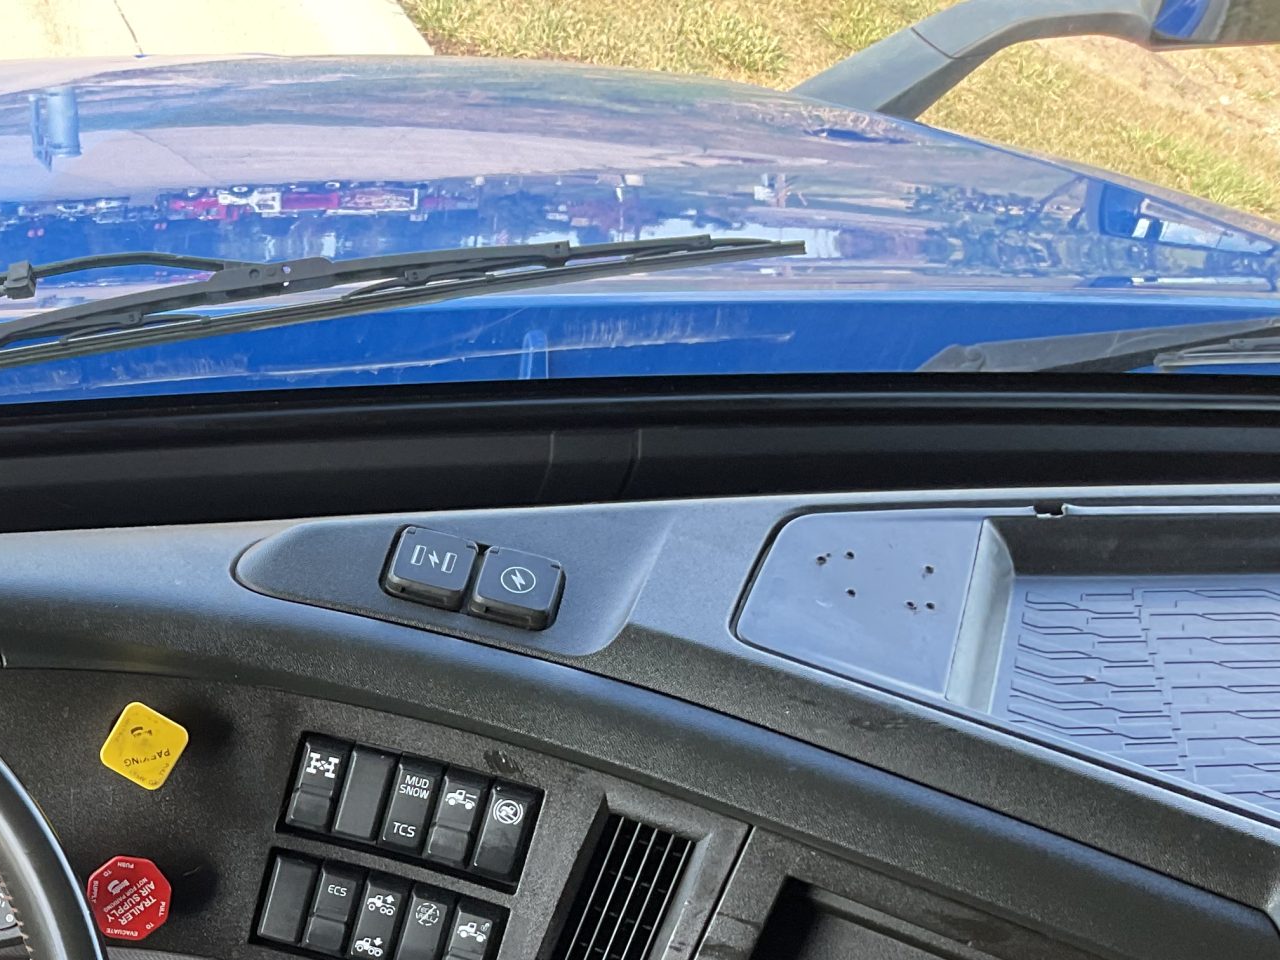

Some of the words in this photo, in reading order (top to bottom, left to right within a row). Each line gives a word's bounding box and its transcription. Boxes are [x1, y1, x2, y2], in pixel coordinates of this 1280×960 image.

[404, 774, 430, 789] MUD
[399, 784, 430, 800] SNOW
[392, 822, 417, 838] TCS
[117, 861, 135, 869] PUSH
[102, 869, 113, 877] TO
[134, 877, 149, 889] NOT
[139, 880, 156, 897] AIR
[327, 884, 348, 897] ECS
[91, 880, 99, 903] SUPPLY
[125, 885, 137, 897] FOR
[103, 893, 127, 913] PARKING
[106, 893, 141, 923] SUPPLY
[117, 895, 157, 926] TRAILER
[158, 901, 166, 918] PULL
[106, 927, 139, 937] EVACUATE
[145, 921, 155, 930] TO
